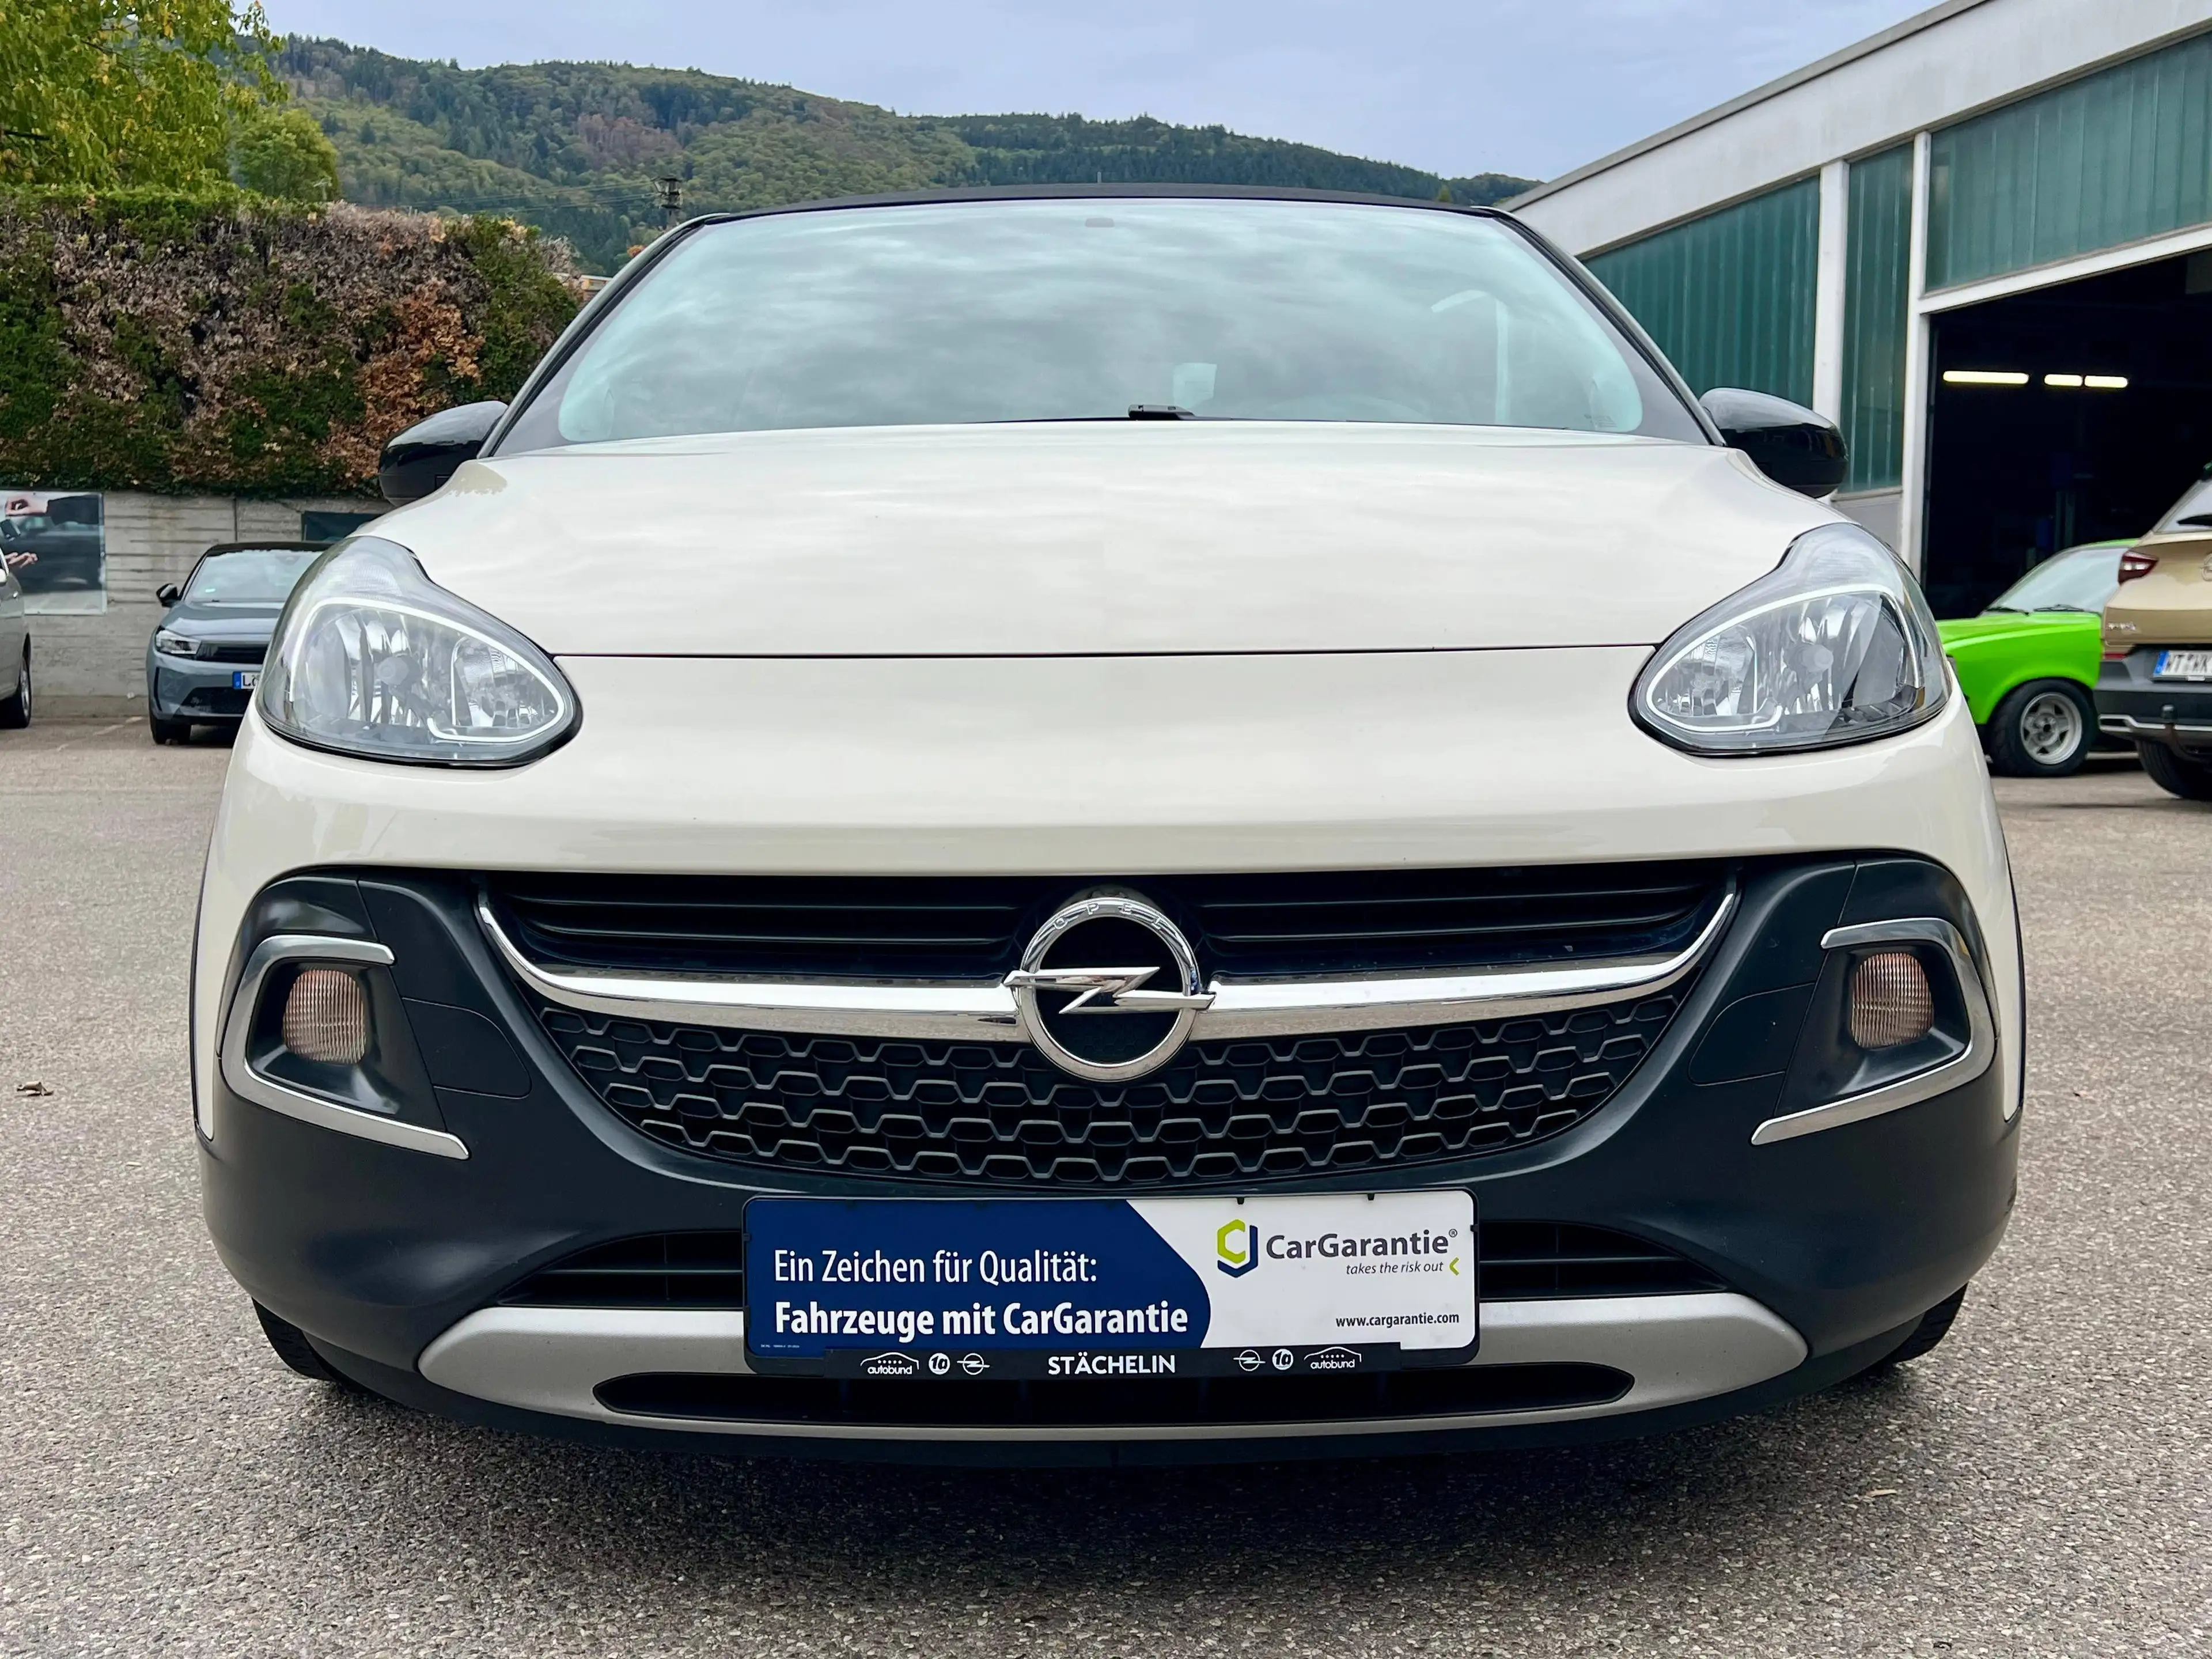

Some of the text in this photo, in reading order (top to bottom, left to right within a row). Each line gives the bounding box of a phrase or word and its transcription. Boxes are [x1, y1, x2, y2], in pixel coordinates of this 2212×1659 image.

[1052, 903, 1164, 931] OPEL
[775, 1250, 1096, 1286] Ein Zeichen für Qualität:
[1347, 1261, 1444, 1274] takes the risk out
[775, 1301, 1187, 1343] Fahrzeuge mit CarGarantie
[1336, 1312, 1459, 1328] www.cargarantie.com
[868, 1365, 912, 1374] autobund
[1048, 1352, 1175, 1374] STÄCHELIN
[1310, 1359, 1355, 1369] autobund
